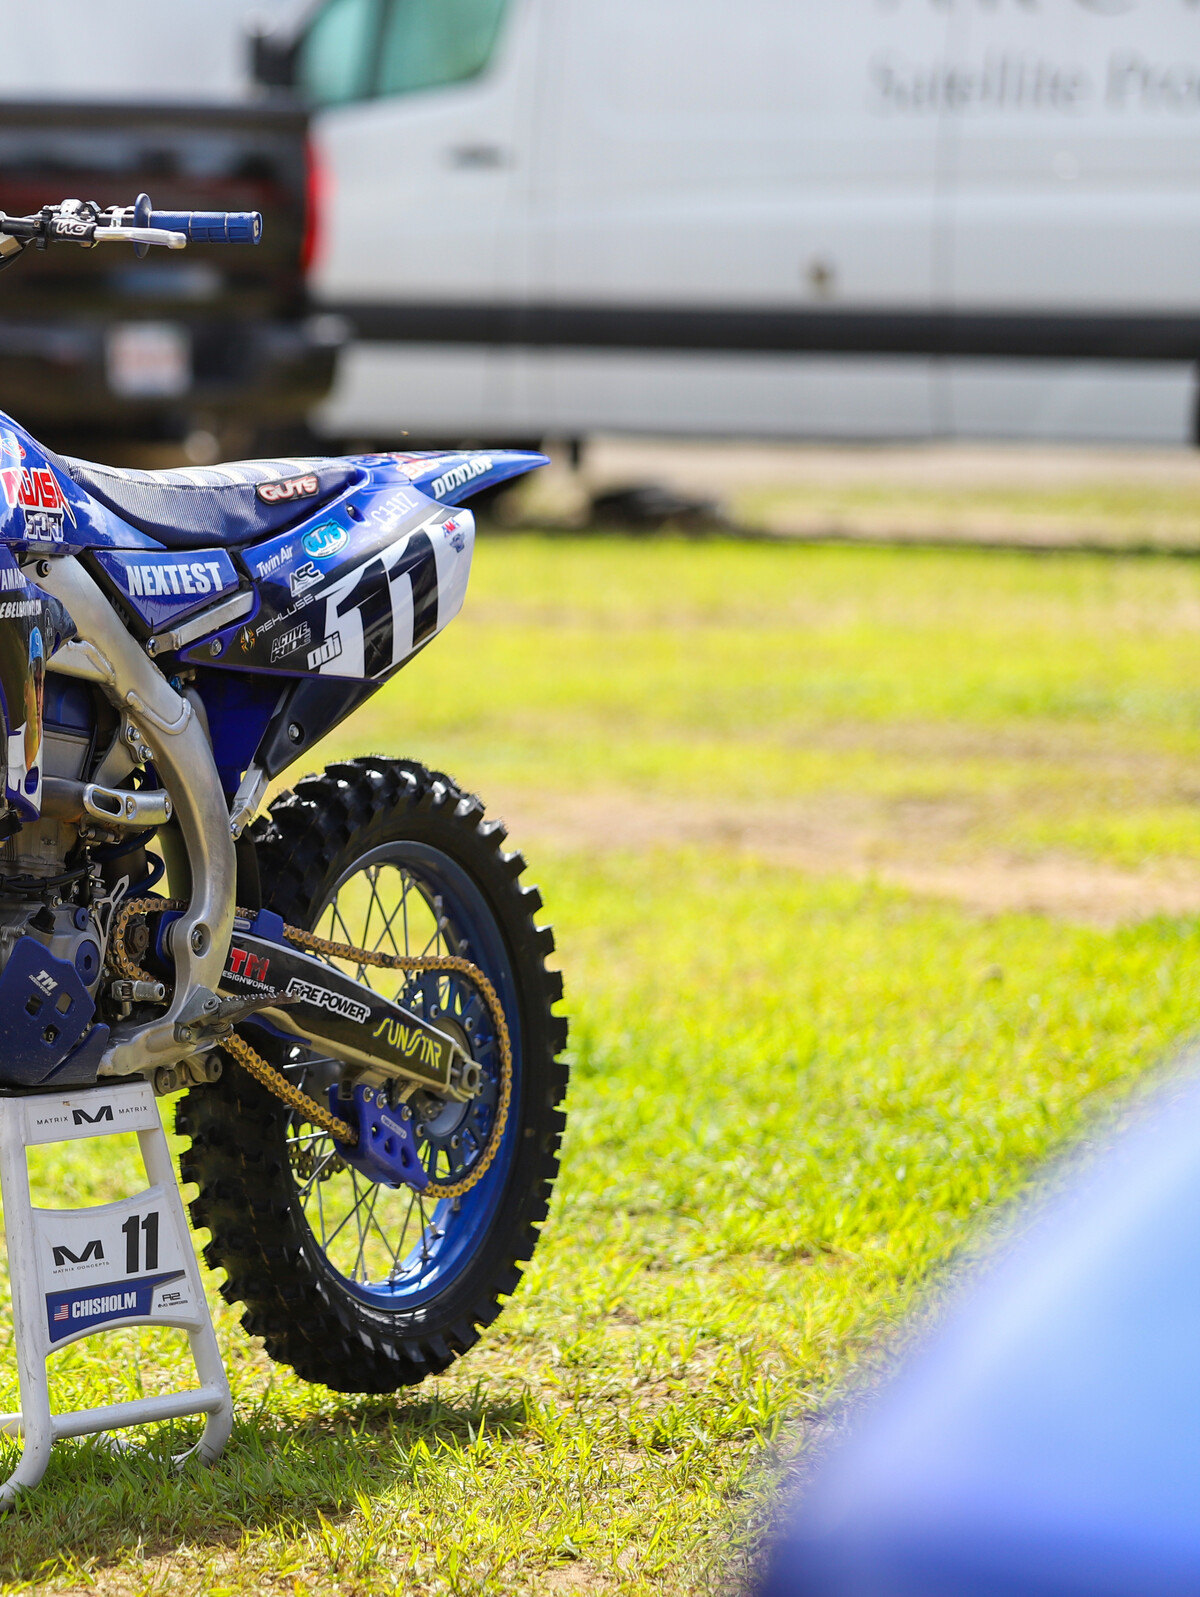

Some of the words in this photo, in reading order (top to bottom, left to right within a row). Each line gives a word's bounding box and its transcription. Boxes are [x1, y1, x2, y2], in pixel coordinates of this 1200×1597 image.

[257, 475, 318, 501] GUTS
[430, 455, 493, 500] DUNLOP
[256, 555, 280, 577] Twin
[280, 544, 294, 563] Air
[126, 561, 224, 597] NEXTEST
[255, 593, 314, 637] REKLUSE
[336, 528, 439, 679] 11
[36, 969, 58, 991] TM
[222, 970, 276, 993] ESIGNWORKS
[230, 947, 270, 983] TM
[36, 1115, 69, 1125] MATRIX
[118, 1106, 148, 1115] MATRIX
[121, 1211, 159, 1274] 11
[52, 1266, 75, 1275] MATRIX
[76, 1261, 110, 1271] CONCEPTS
[71, 1291, 137, 1319] CHISHOLM
